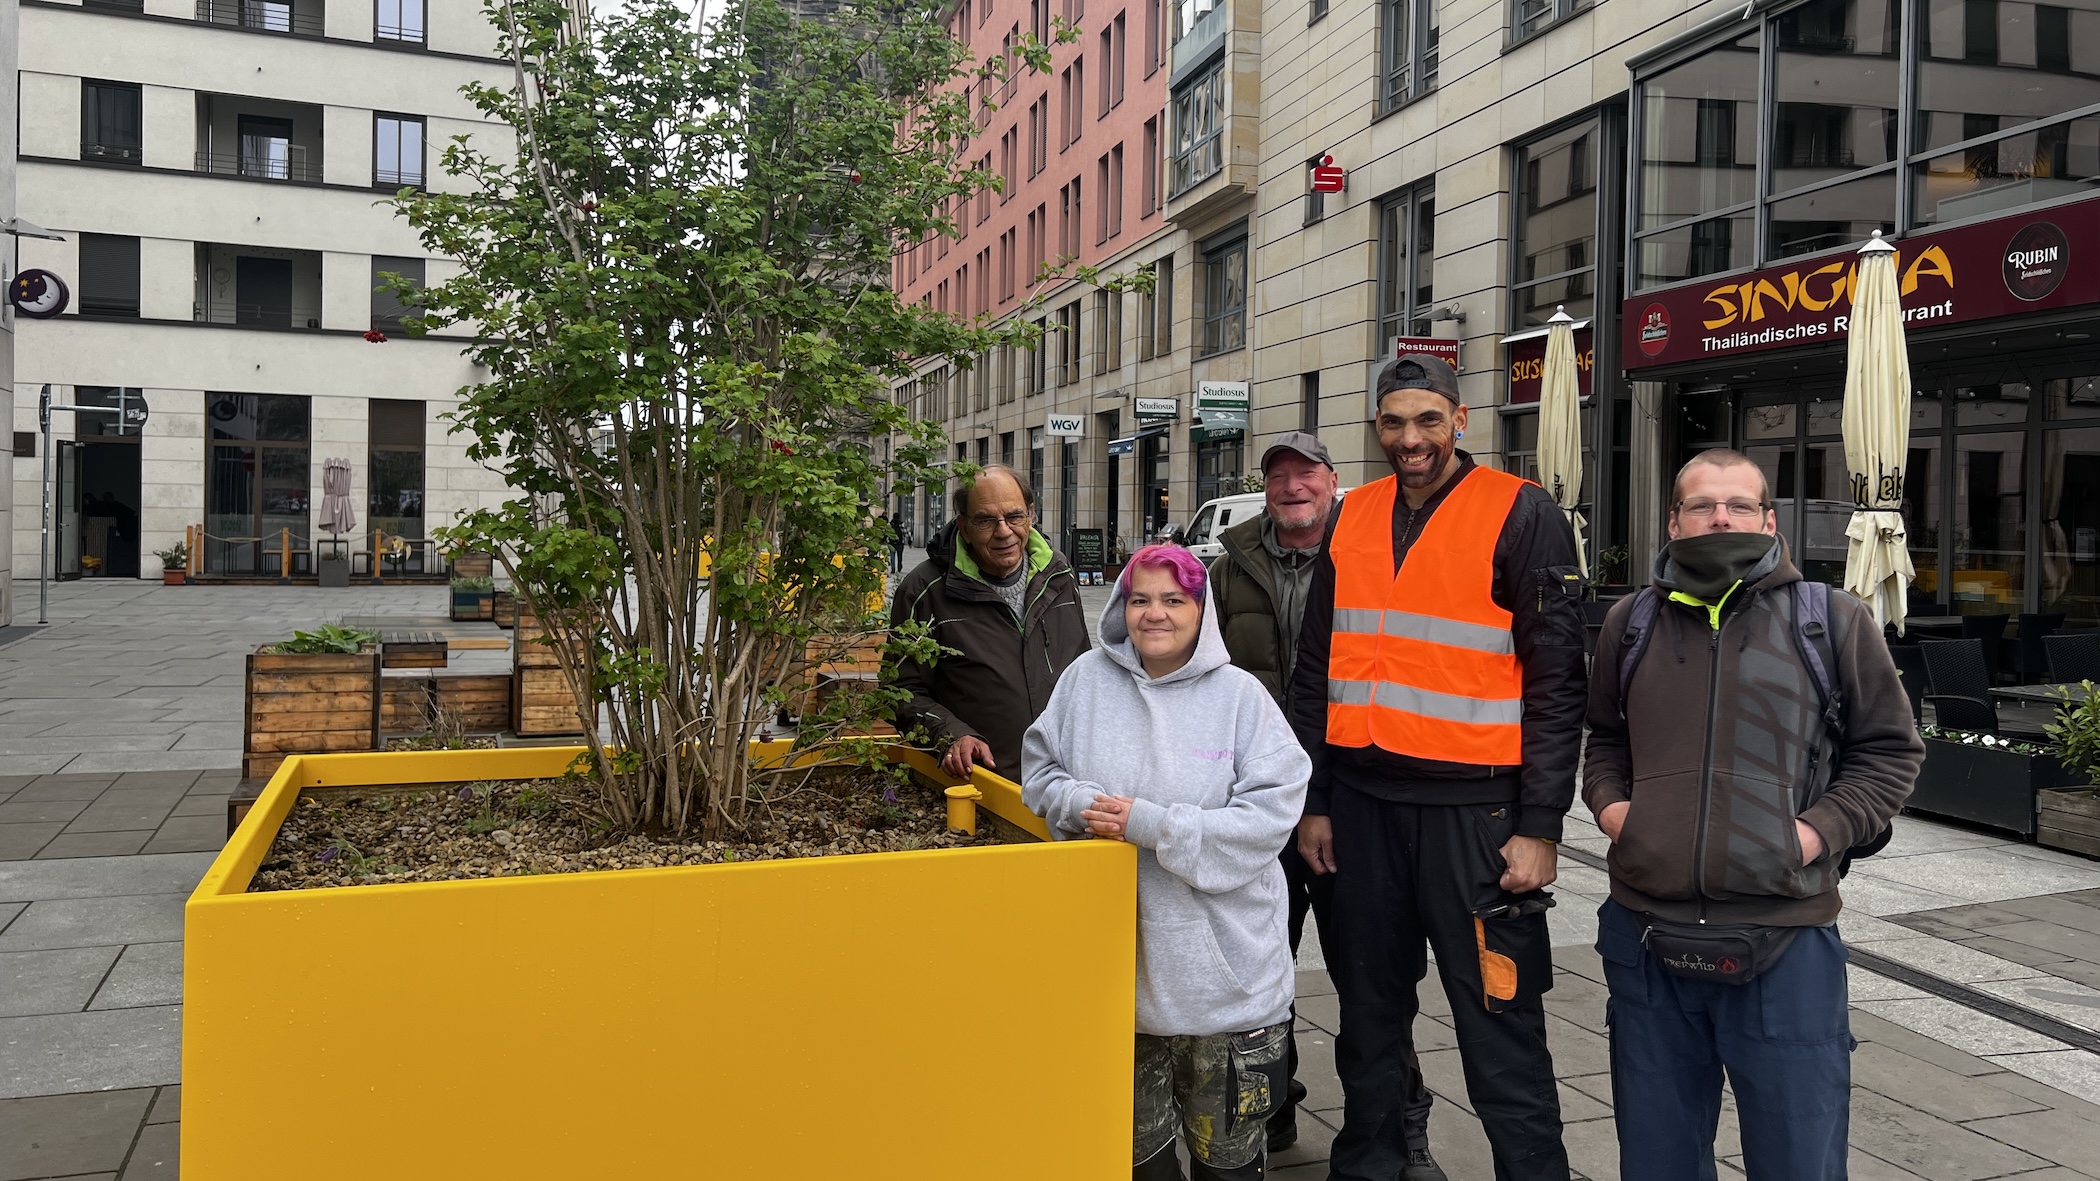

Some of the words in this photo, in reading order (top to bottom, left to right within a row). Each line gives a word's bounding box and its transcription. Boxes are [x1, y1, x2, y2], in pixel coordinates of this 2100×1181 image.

[2008, 246, 2058, 269] RUBIN
[1702, 322, 1828, 352] Thailändisches
[1398, 342, 1457, 352] Restaurant
[1202, 386, 1245, 397] Studiosus
[1139, 401, 1175, 410] Studiosus
[1050, 419, 1080, 431] WGV
